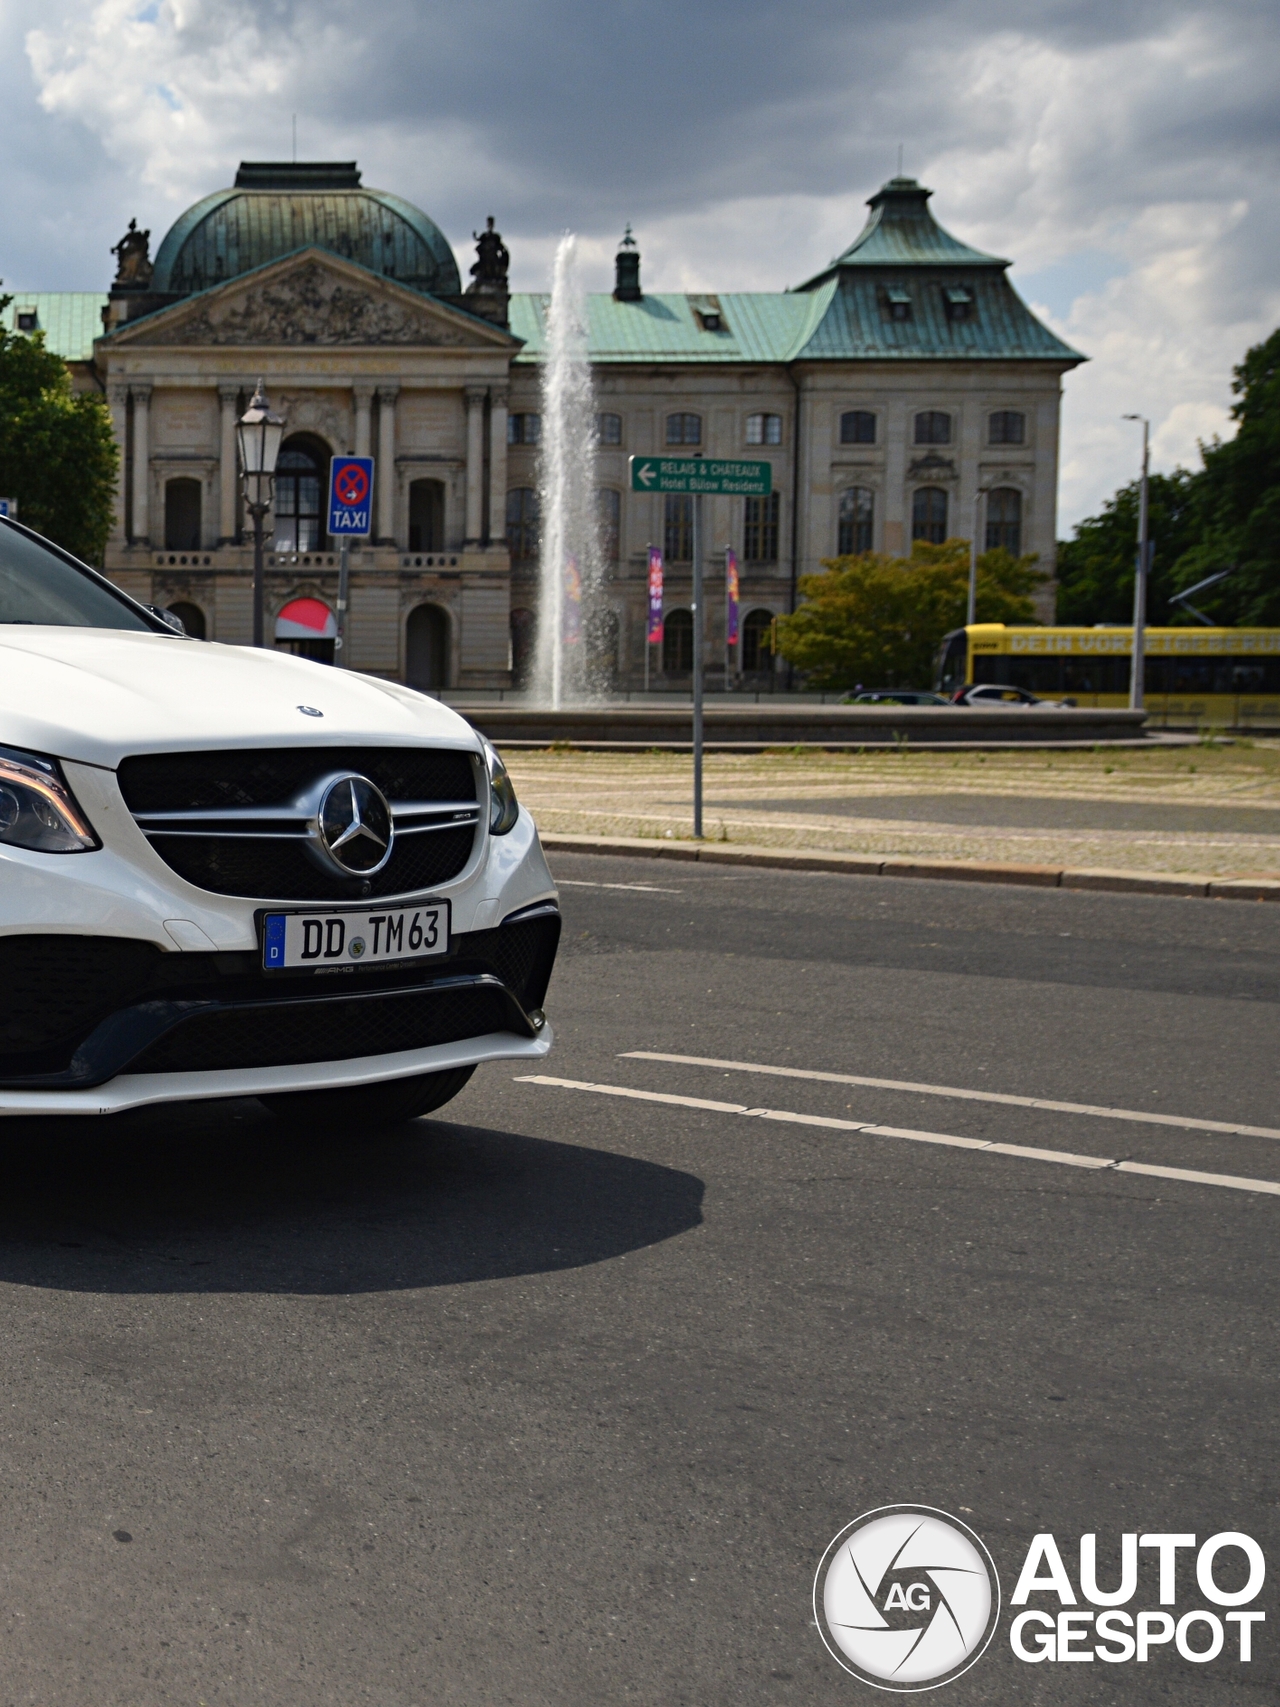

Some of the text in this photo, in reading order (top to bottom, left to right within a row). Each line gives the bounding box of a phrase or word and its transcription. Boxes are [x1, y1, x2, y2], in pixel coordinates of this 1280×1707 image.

[660, 462, 696, 475] RELAIS
[699, 464, 707, 475] &
[660, 478, 764, 492] Hotel Bülow Residenz
[333, 510, 367, 529] TAXI
[301, 918, 345, 959] DD
[270, 947, 278, 959] D
[326, 966, 355, 974] AMG
